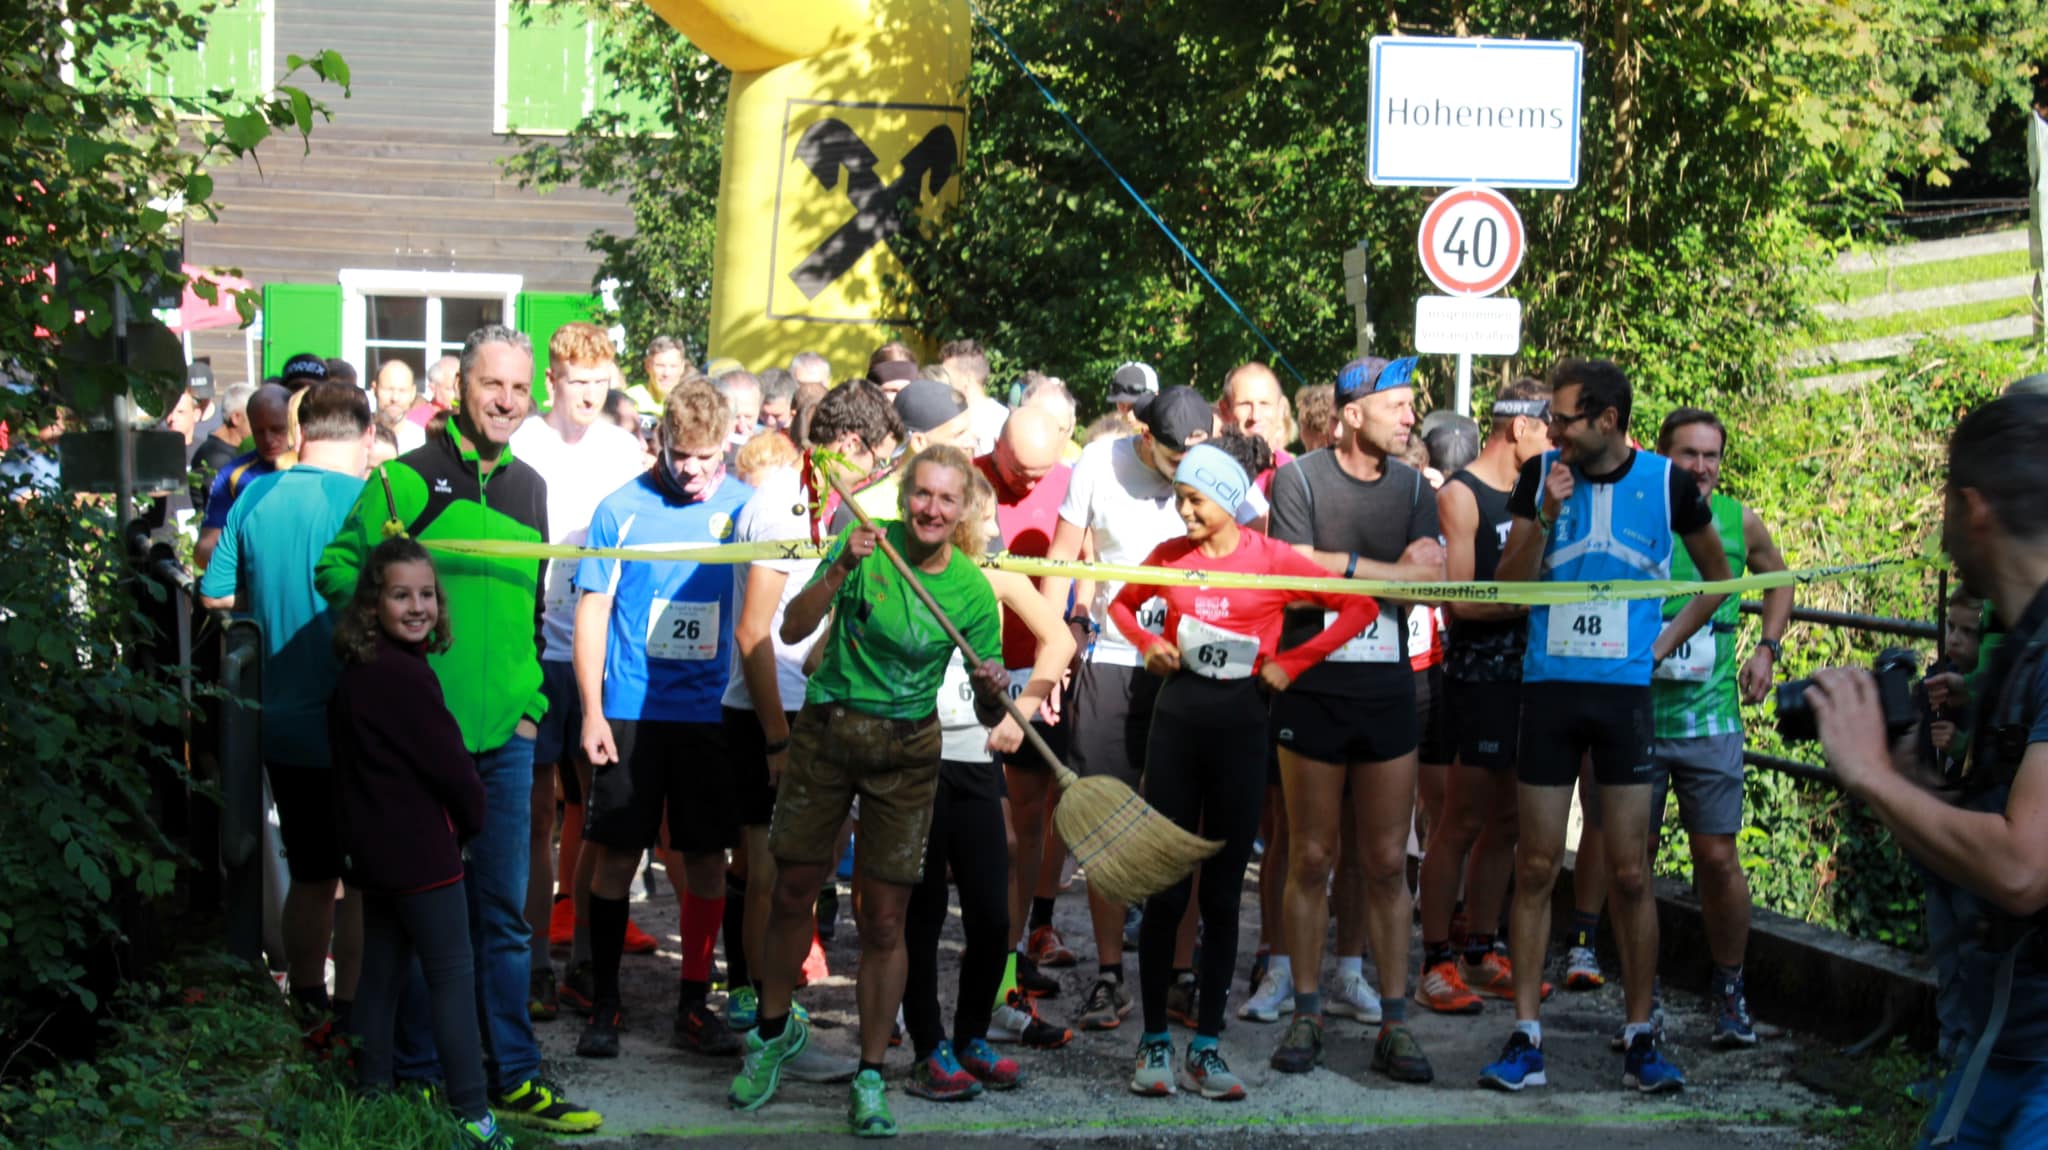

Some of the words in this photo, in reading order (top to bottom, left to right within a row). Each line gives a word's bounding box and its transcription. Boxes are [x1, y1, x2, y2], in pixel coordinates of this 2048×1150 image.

[1388, 96, 1563, 130] Hohenems
[1443, 216, 1498, 268] 40
[672, 618, 701, 641] 26
[1572, 614, 1603, 636] 48
[1198, 643, 1229, 669] 63
